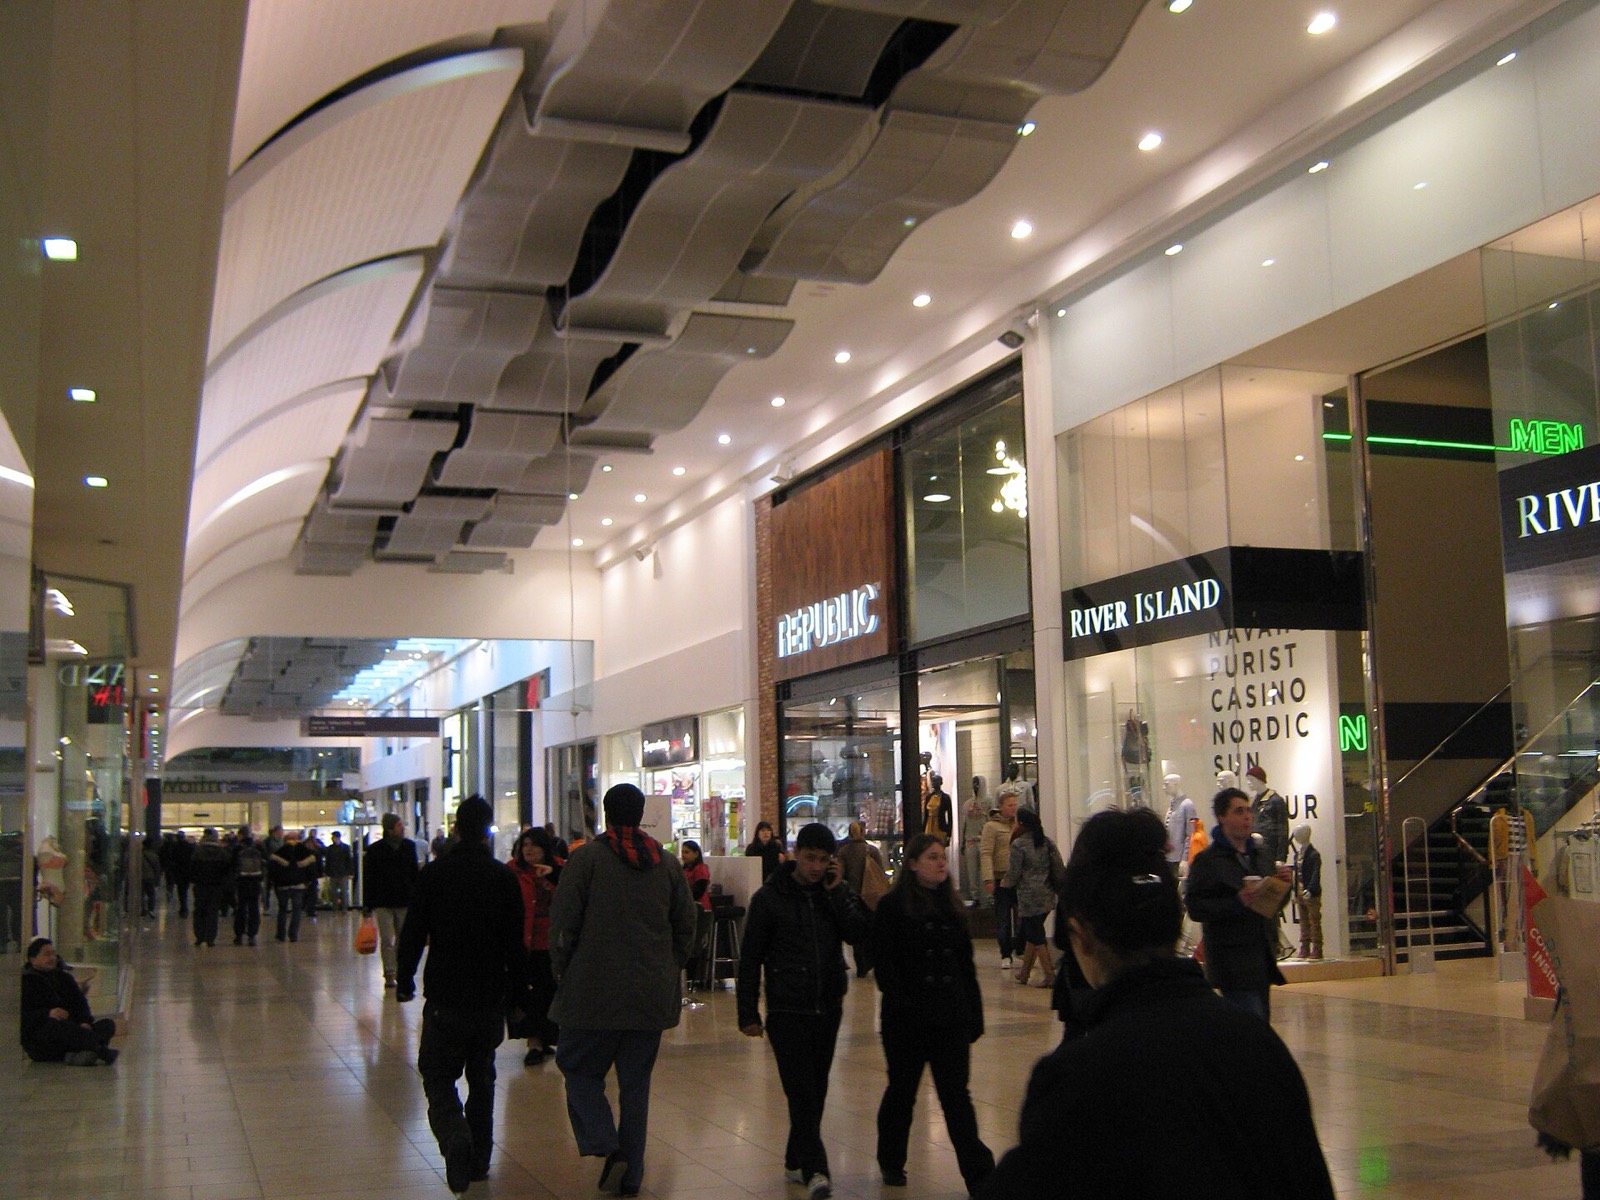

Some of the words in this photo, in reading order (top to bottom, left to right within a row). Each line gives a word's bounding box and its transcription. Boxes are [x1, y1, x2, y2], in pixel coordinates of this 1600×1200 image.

[1510, 418, 1584, 455] MEN
[778, 583, 880, 658] REPUBLIC
[1070, 600, 1130, 638] RIVER
[1134, 578, 1221, 624] ISLAND
[1210, 643, 1297, 681] PURIST
[1211, 677, 1306, 713] CASINO
[1212, 712, 1310, 746] NORDIC
[1214, 751, 1260, 777] SUN
